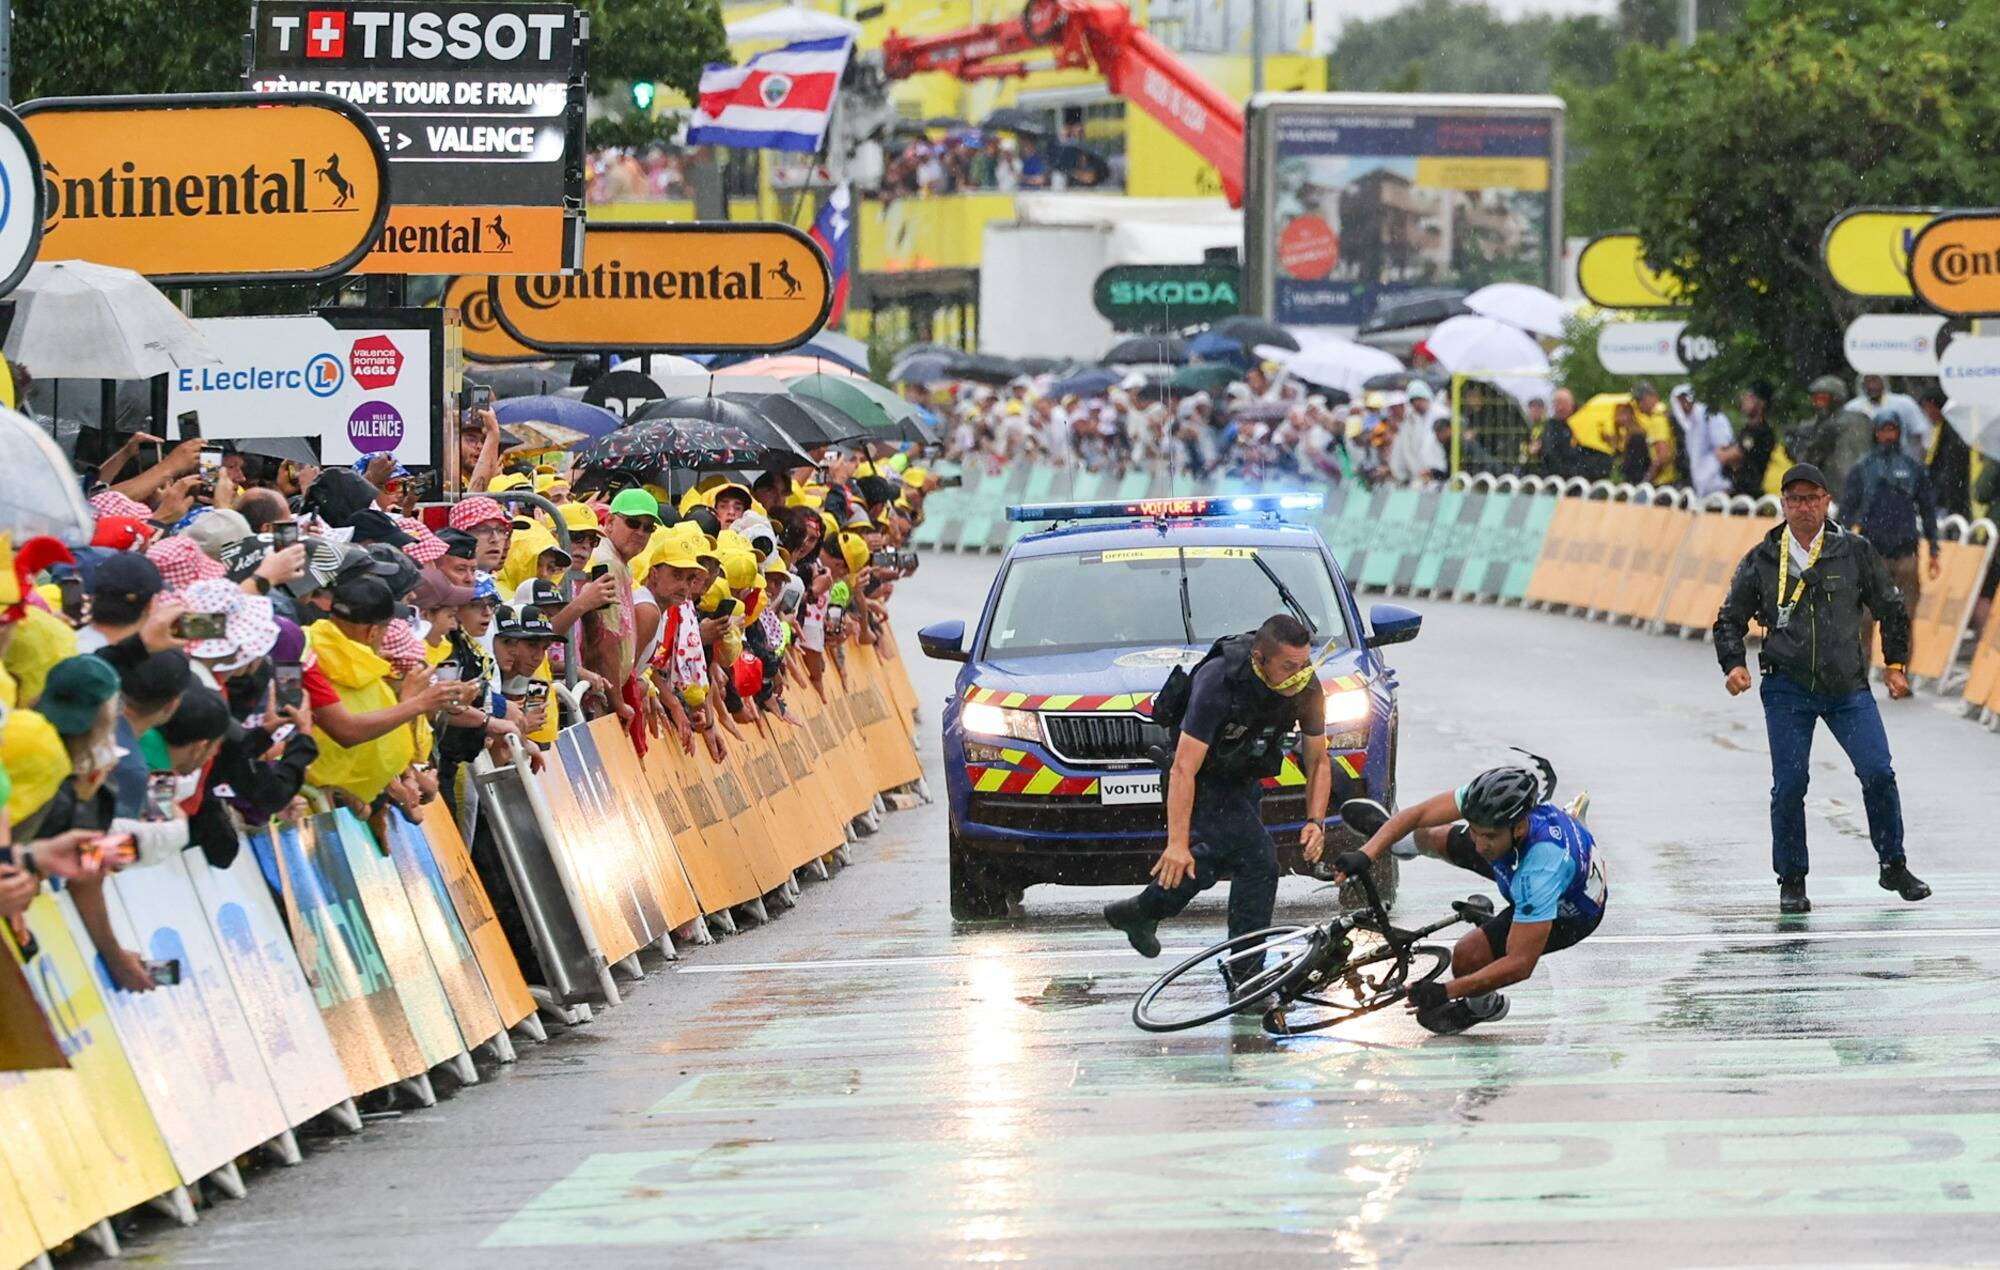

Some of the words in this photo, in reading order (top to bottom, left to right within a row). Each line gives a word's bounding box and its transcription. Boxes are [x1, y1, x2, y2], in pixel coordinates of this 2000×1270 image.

[352, 12, 566, 61] TISSOT
[392, 82, 451, 105] TOUR
[454, 82, 483, 105] DE
[486, 82, 569, 106] FRANCE
[425, 126, 535, 152] VALENCE
[42, 158, 308, 236] ontinental
[514, 260, 763, 310] Continental
[178, 366, 301, 392] E.Leclerc
[350, 420, 402, 438] VALENCE
[1140, 500, 1194, 515] VOITURE
[1223, 548, 1244, 557] 41
[1103, 783, 1162, 796] VOITUR
